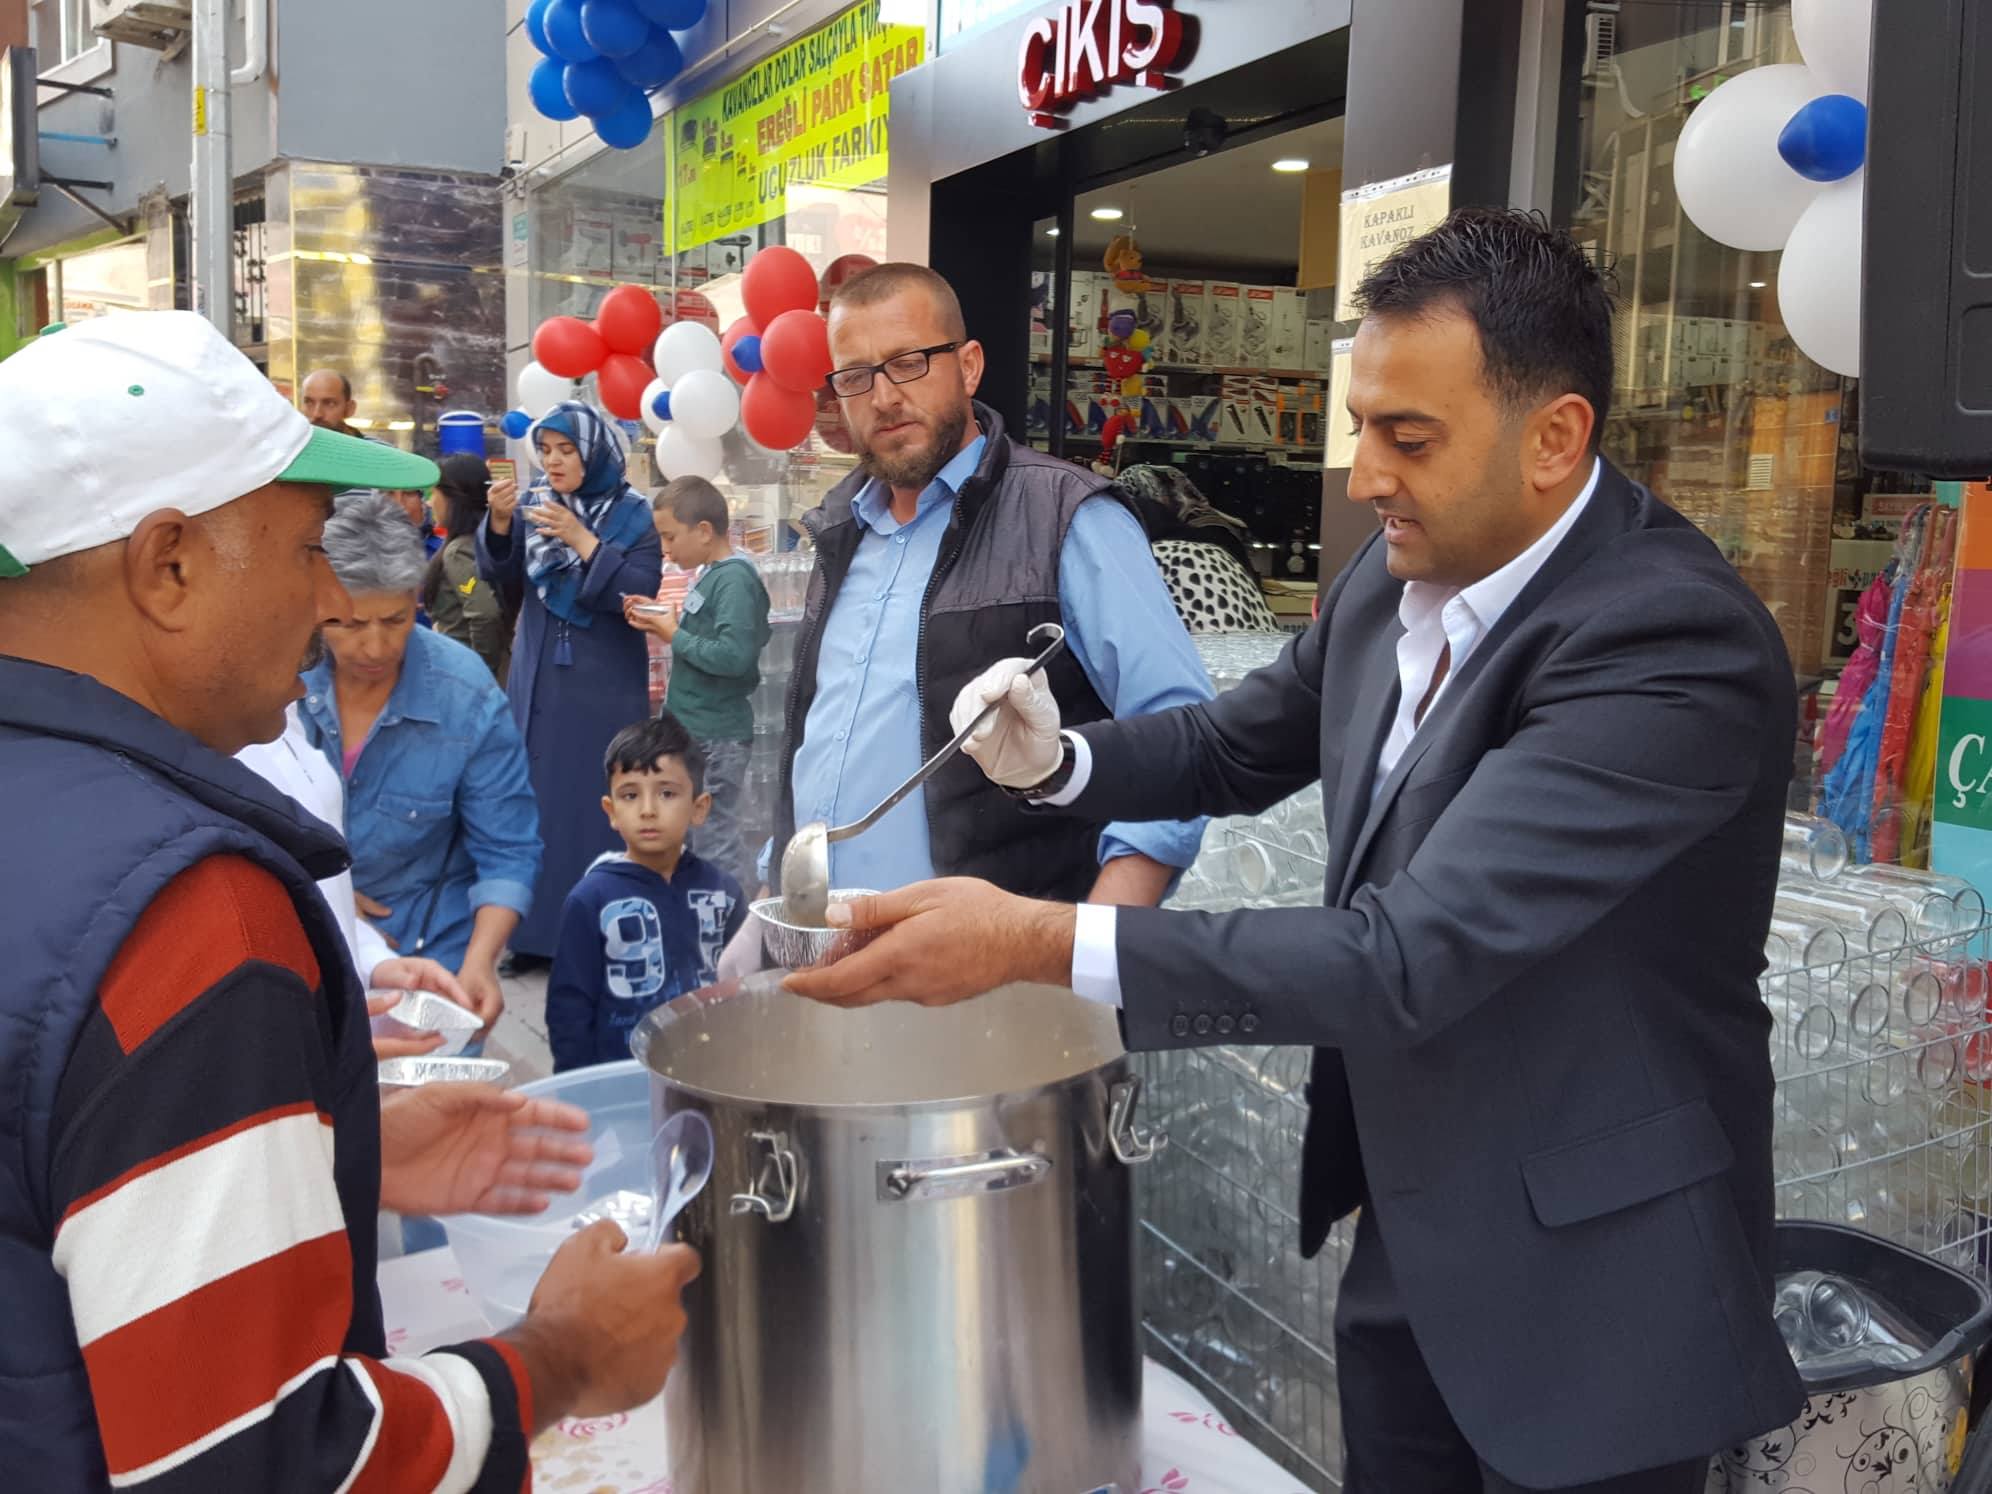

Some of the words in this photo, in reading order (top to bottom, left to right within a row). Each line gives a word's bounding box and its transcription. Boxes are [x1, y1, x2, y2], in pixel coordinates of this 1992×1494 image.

[775, 42, 806, 92] DOLAR
[808, 9, 857, 76] SALÇAYLA
[1017, 0, 1165, 128] ÇIKIŞ
[757, 86, 807, 155] EREĞLİ
[812, 70, 855, 128] PARK
[859, 36, 918, 105] SATAR
[758, 145, 827, 204] UCUZLUK
[1360, 226, 1416, 250] KAVANOZ
[1364, 205, 1415, 229] KAPAKLI
